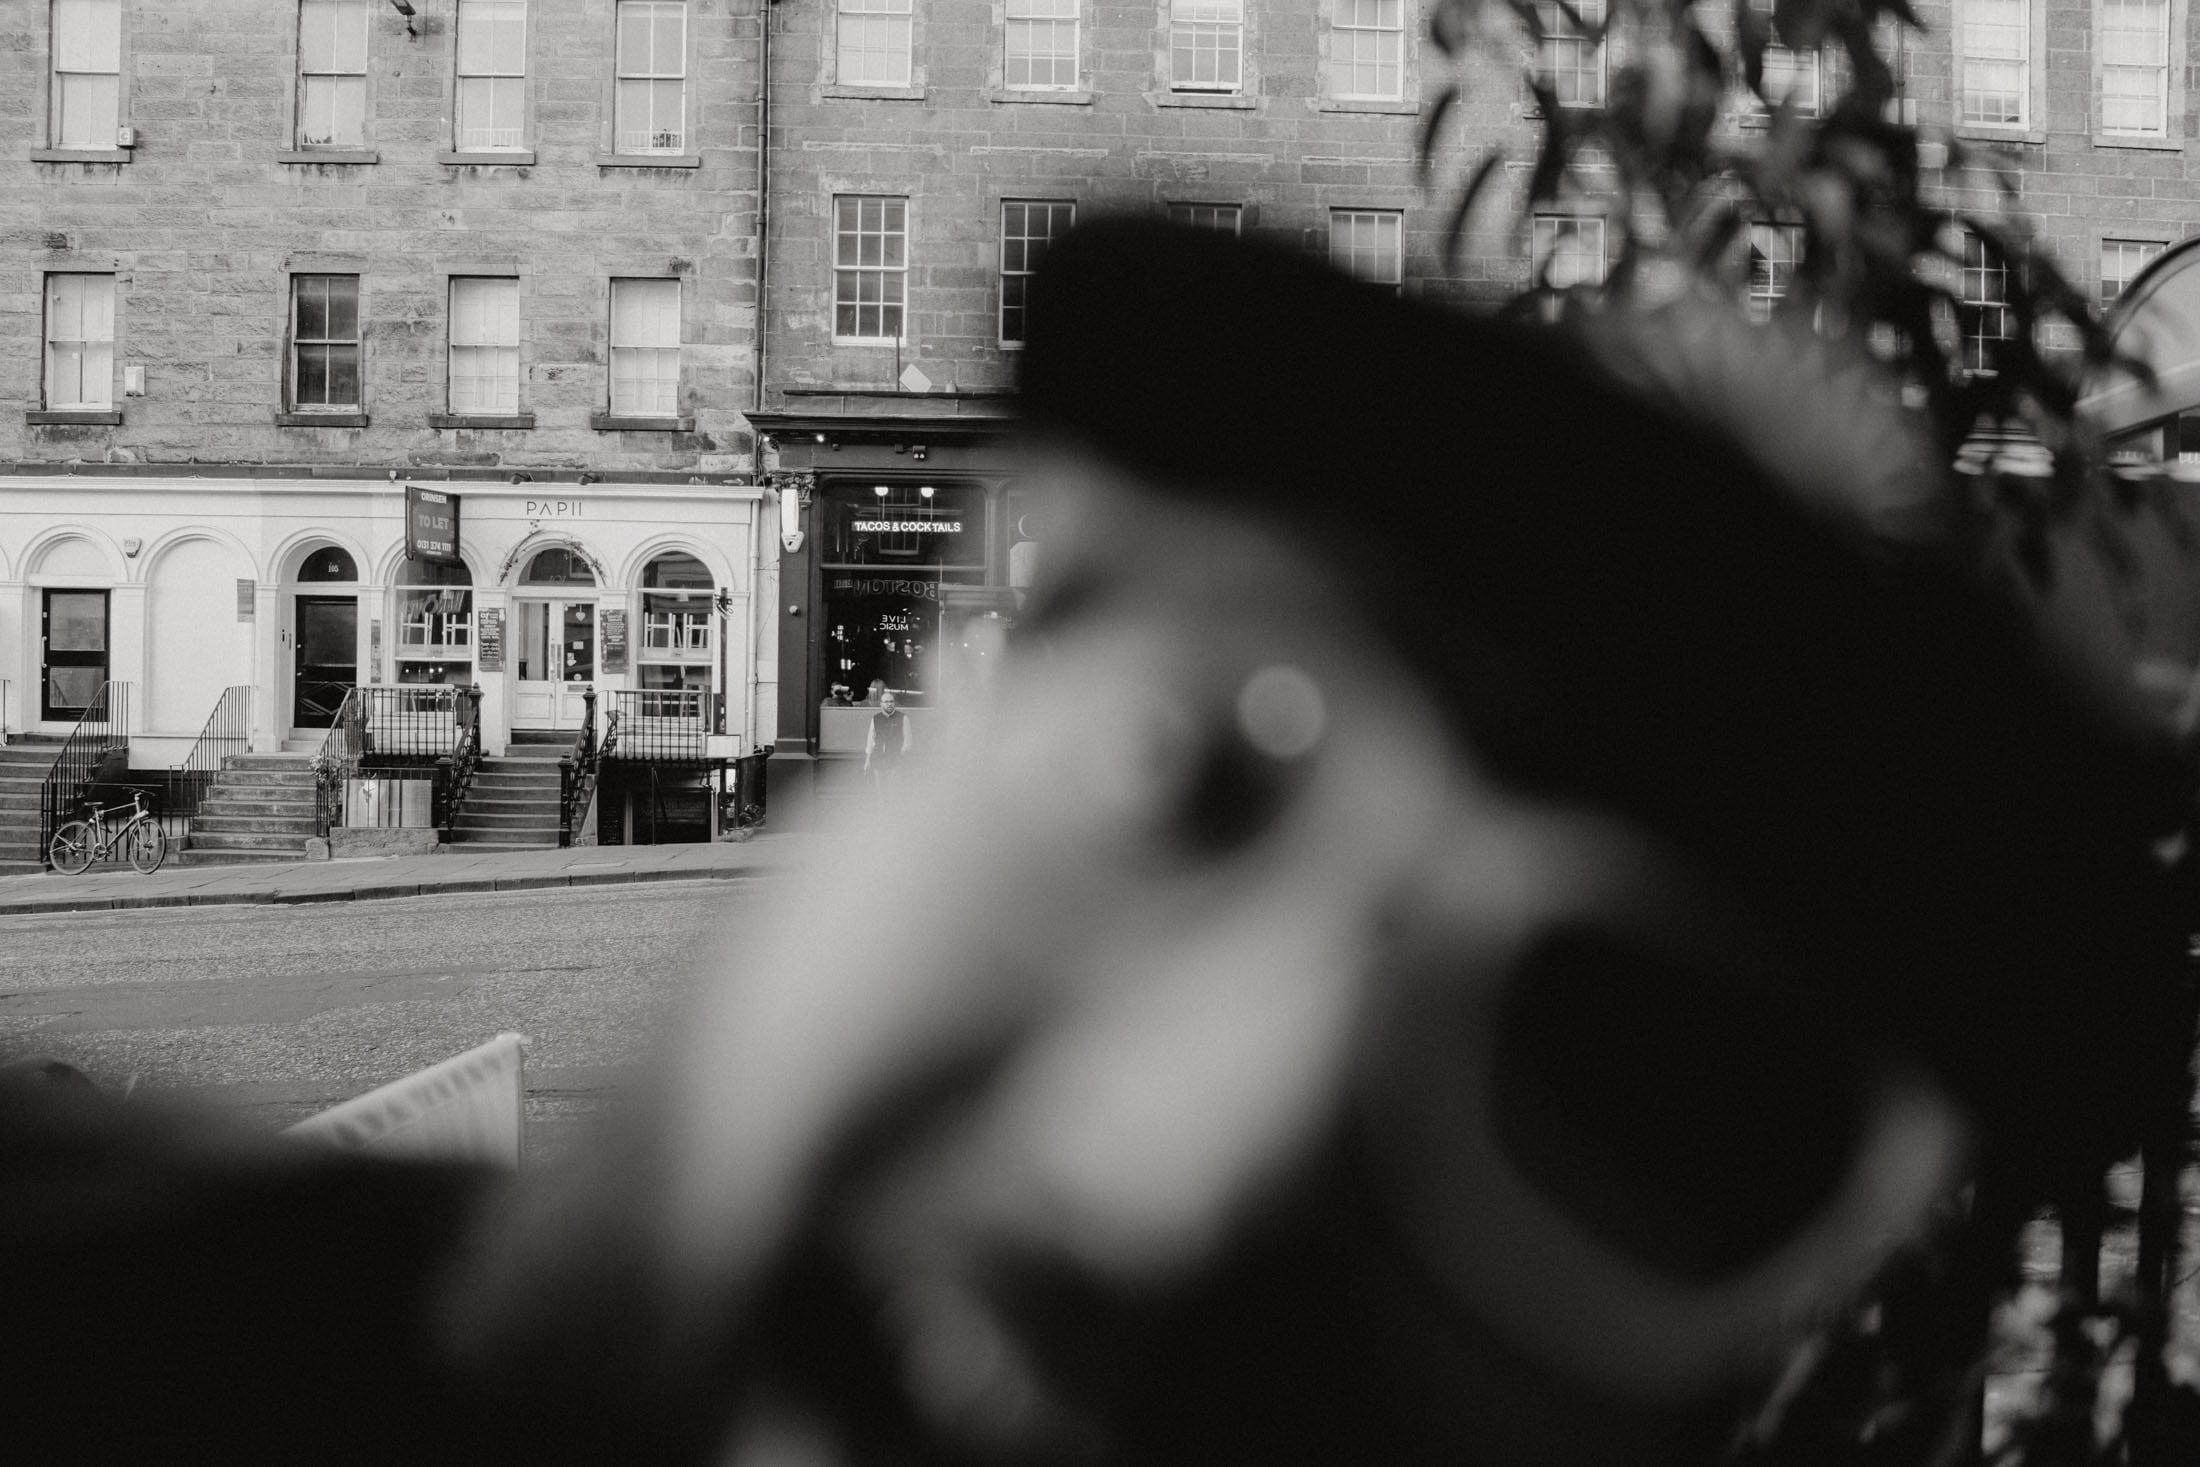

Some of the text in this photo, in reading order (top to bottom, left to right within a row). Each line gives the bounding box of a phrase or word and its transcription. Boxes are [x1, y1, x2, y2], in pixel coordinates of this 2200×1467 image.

[418, 515, 449, 529] TO LET
[855, 521, 961, 533] TACOS & COCKTAILS
